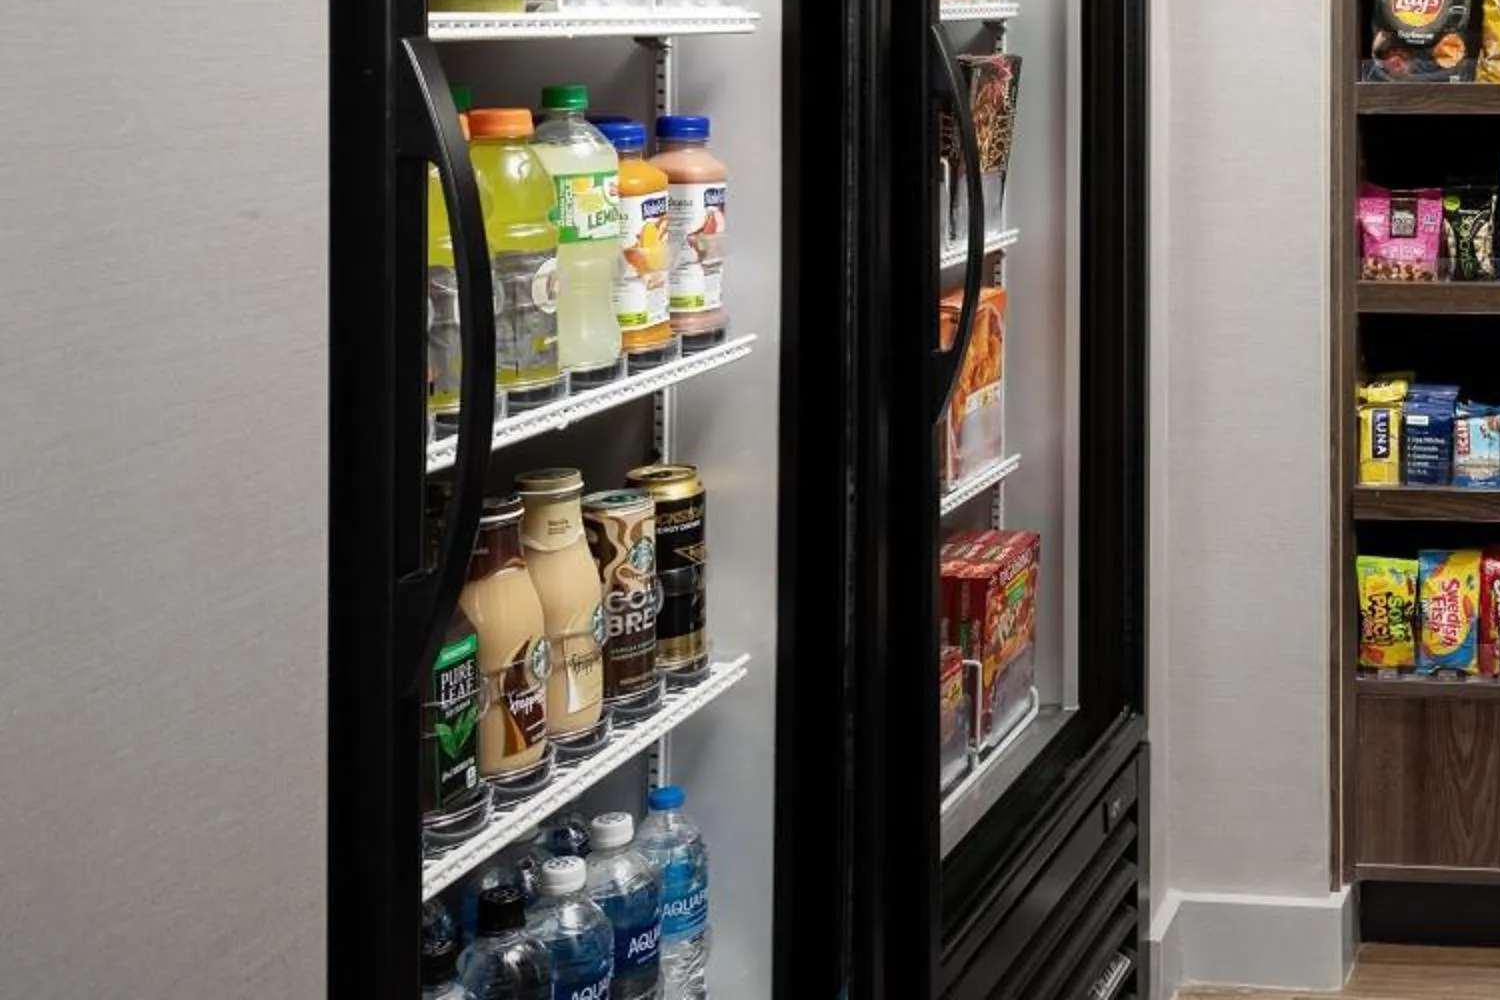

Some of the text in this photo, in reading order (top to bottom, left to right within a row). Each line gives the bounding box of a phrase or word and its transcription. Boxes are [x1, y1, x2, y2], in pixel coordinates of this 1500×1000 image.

[1374, 412, 1387, 455] LUNA
[609, 608, 656, 637] BRE
[1429, 597, 1446, 634] Fish
[1441, 580, 1460, 648] Swedish
[441, 660, 475, 688] PURE
